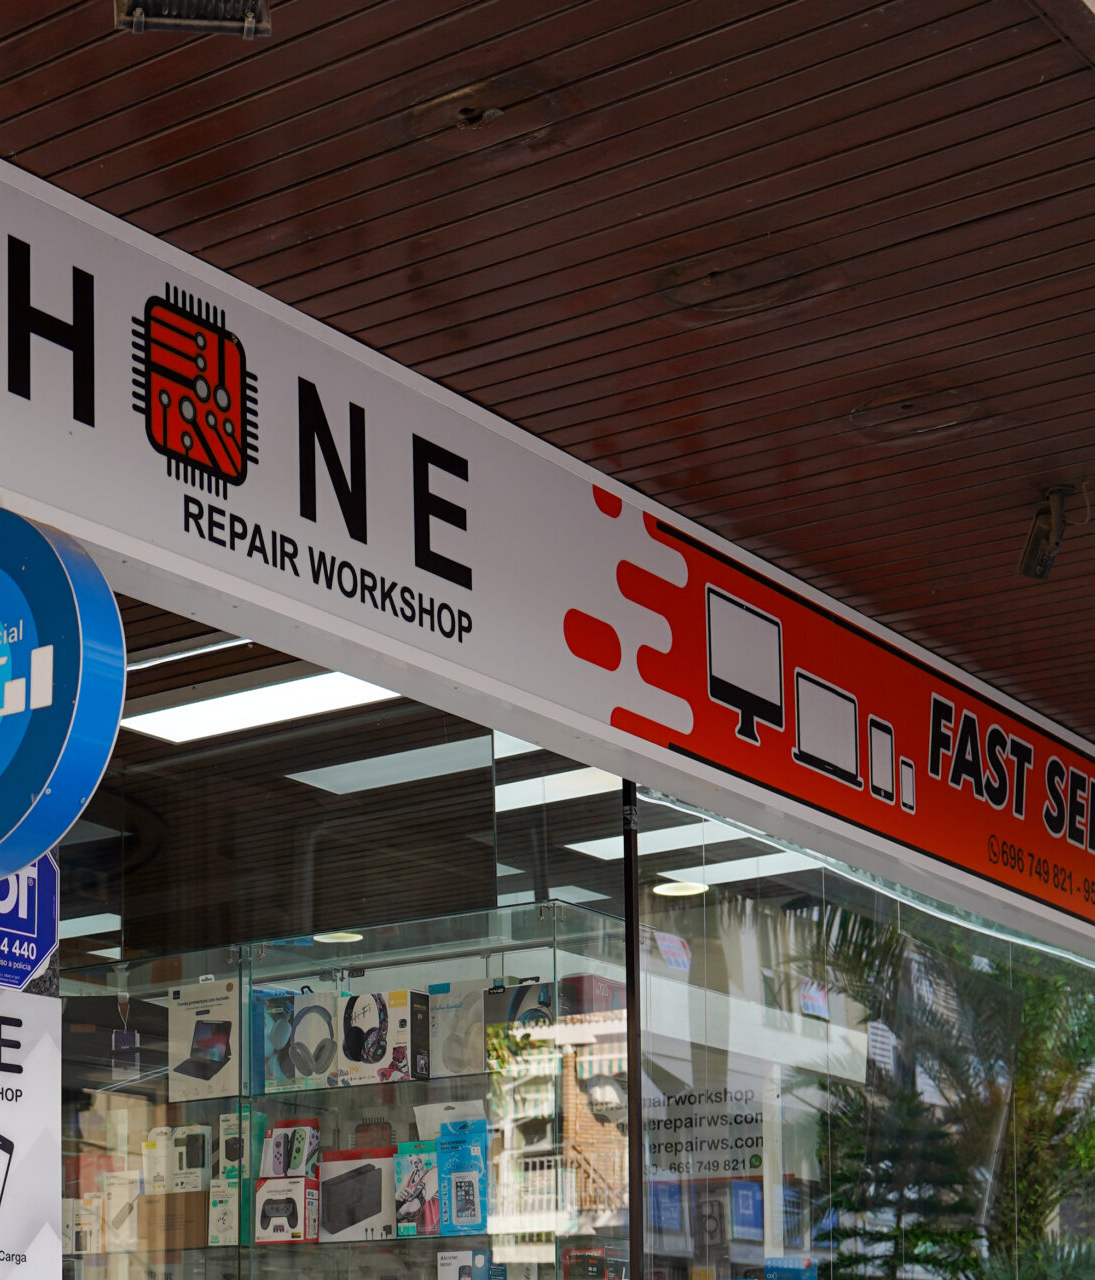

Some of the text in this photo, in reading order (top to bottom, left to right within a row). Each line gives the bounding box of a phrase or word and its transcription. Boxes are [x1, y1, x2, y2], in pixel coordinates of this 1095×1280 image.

[183, 494, 473, 643] REPAIR WORKSHOP
[928, 692, 1034, 820] FAST
[1001, 841, 1024, 873] 696
[1028, 852, 1049, 884] 749
[1053, 864, 1073, 895] 821
[12, 940, 37, 960] 440
[697, 1160, 720, 1173] 749
[723, 1158, 746, 1171] 821
